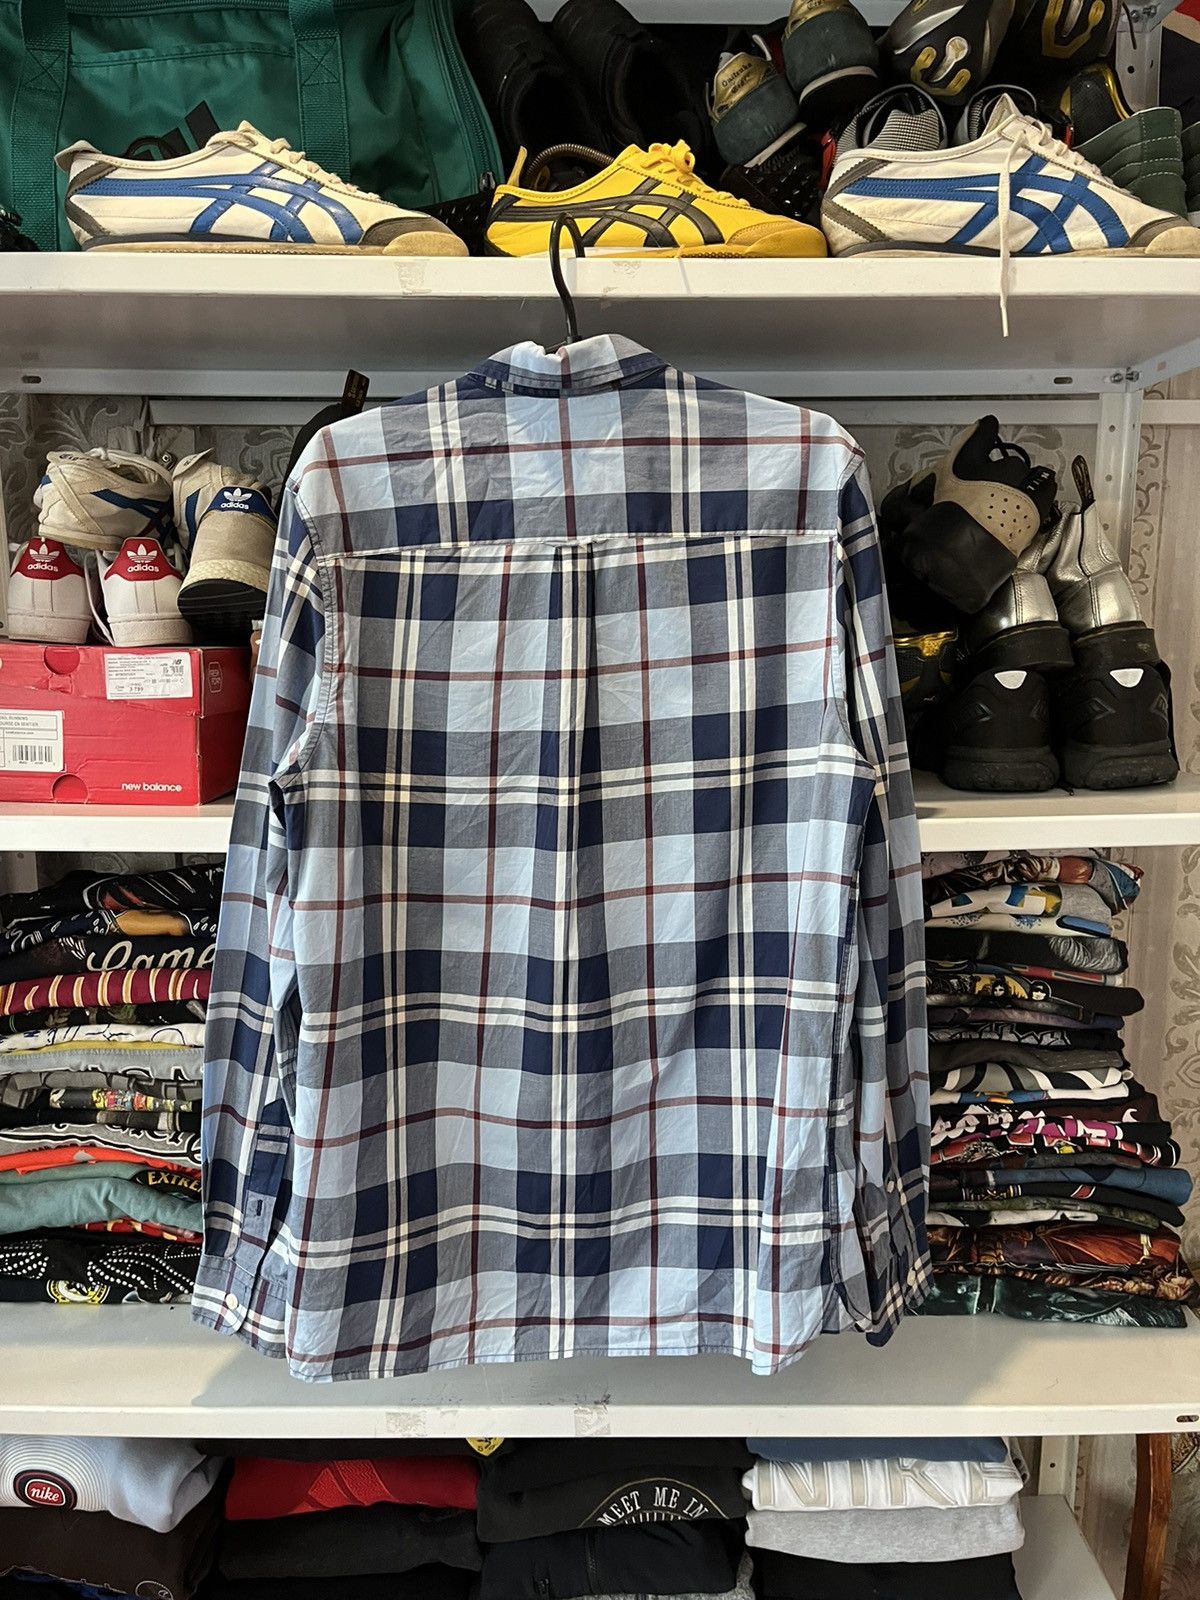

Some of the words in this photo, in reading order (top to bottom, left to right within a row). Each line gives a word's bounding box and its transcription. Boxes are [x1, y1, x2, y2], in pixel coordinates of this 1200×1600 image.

[221, 501, 250, 510] adidas
[27, 563, 59, 573] adidas
[127, 563, 160, 573] adidas
[121, 783, 141, 791] new
[143, 782, 182, 792] balance
[147, 1171, 202, 1193] EXTRE
[31, 1486, 60, 1502] nike
[597, 1490, 641, 1526] MEET
[653, 1486, 680, 1509] ME
[682, 1497, 709, 1519] IN
